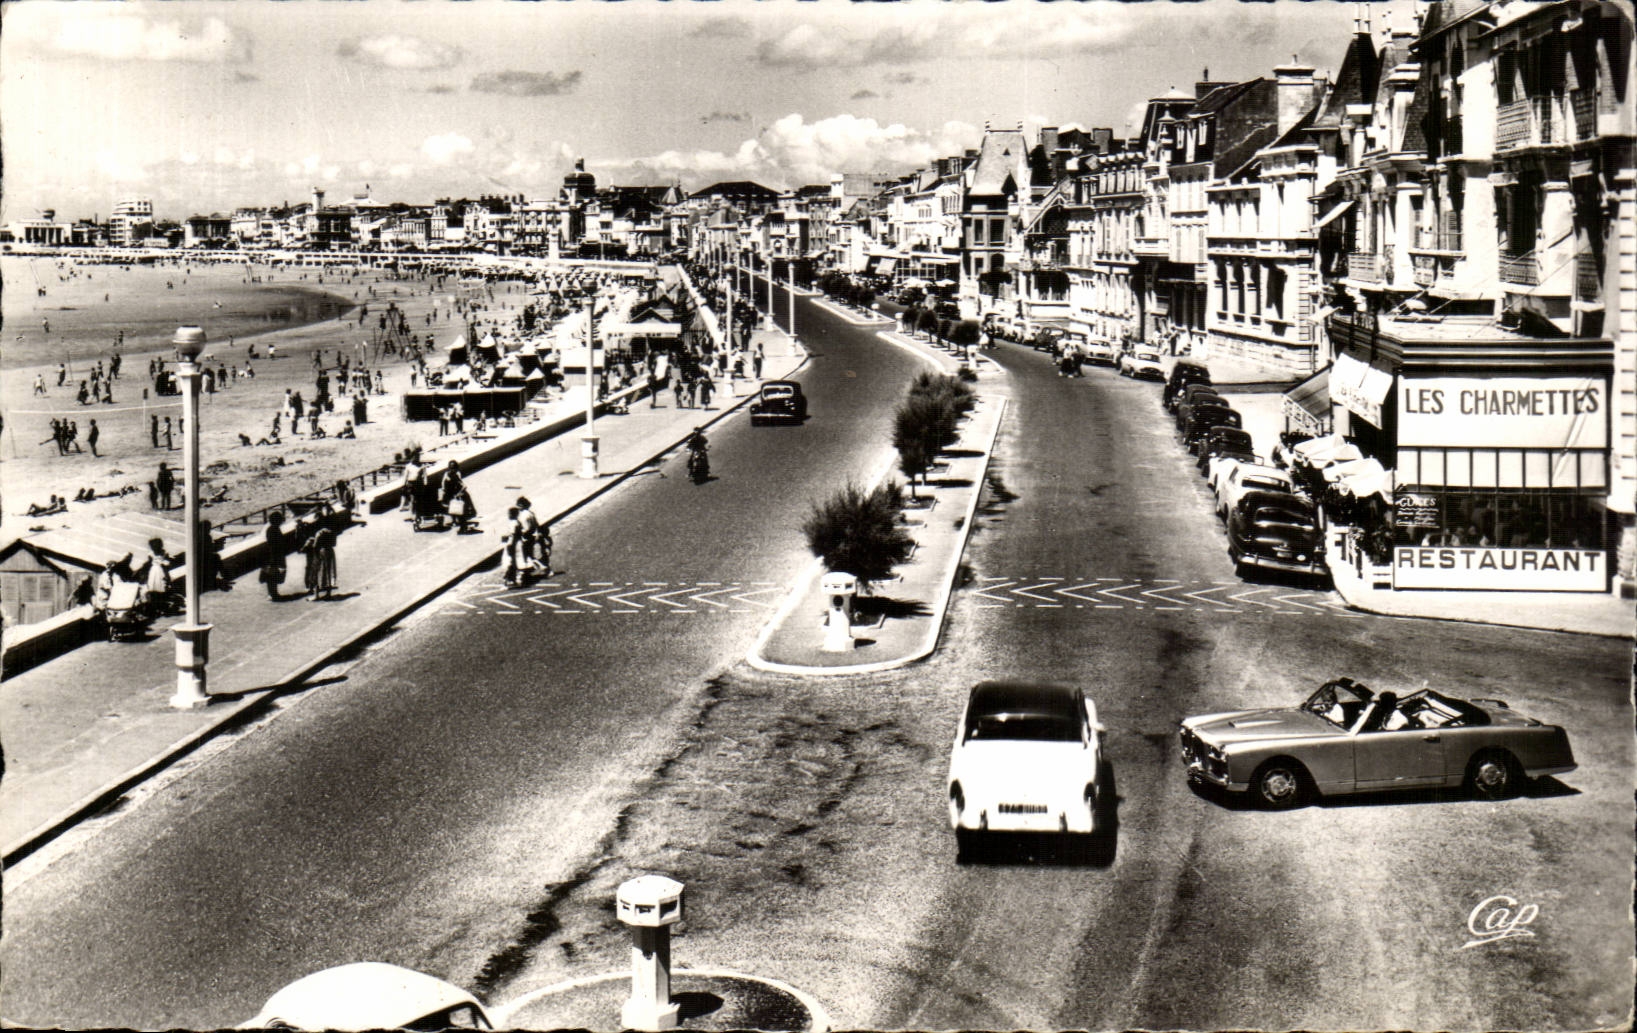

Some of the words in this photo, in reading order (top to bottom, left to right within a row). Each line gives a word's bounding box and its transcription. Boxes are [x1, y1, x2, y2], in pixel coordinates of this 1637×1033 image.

[1405, 388, 1445, 415] LES
[1460, 388, 1600, 416] CHARMETTES
[1399, 548, 1600, 572] RESTAURANT
